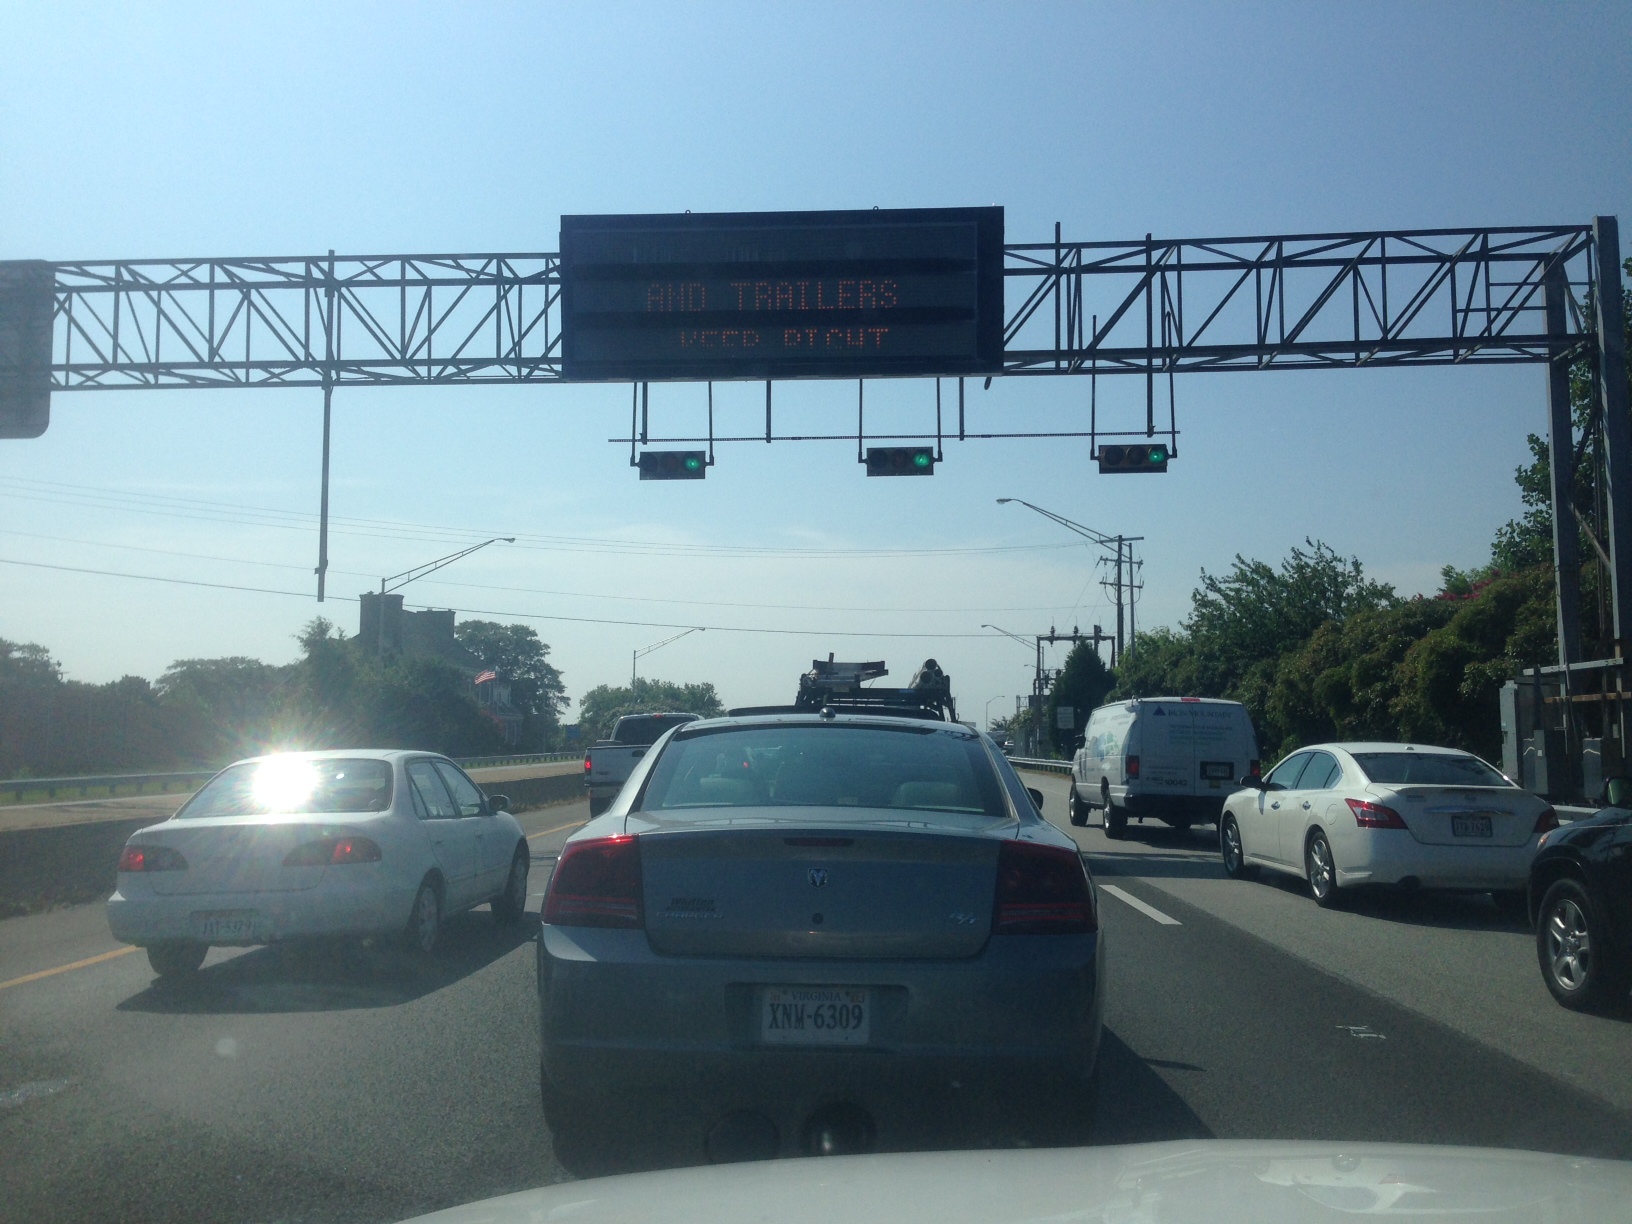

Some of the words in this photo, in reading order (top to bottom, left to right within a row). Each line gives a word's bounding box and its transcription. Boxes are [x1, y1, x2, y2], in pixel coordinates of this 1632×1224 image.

[647, 282, 706, 312] AND
[730, 279, 898, 311] TRAILERS
[791, 991, 842, 1002] VIRGINIA
[768, 1003, 864, 1030] XNM-6309
